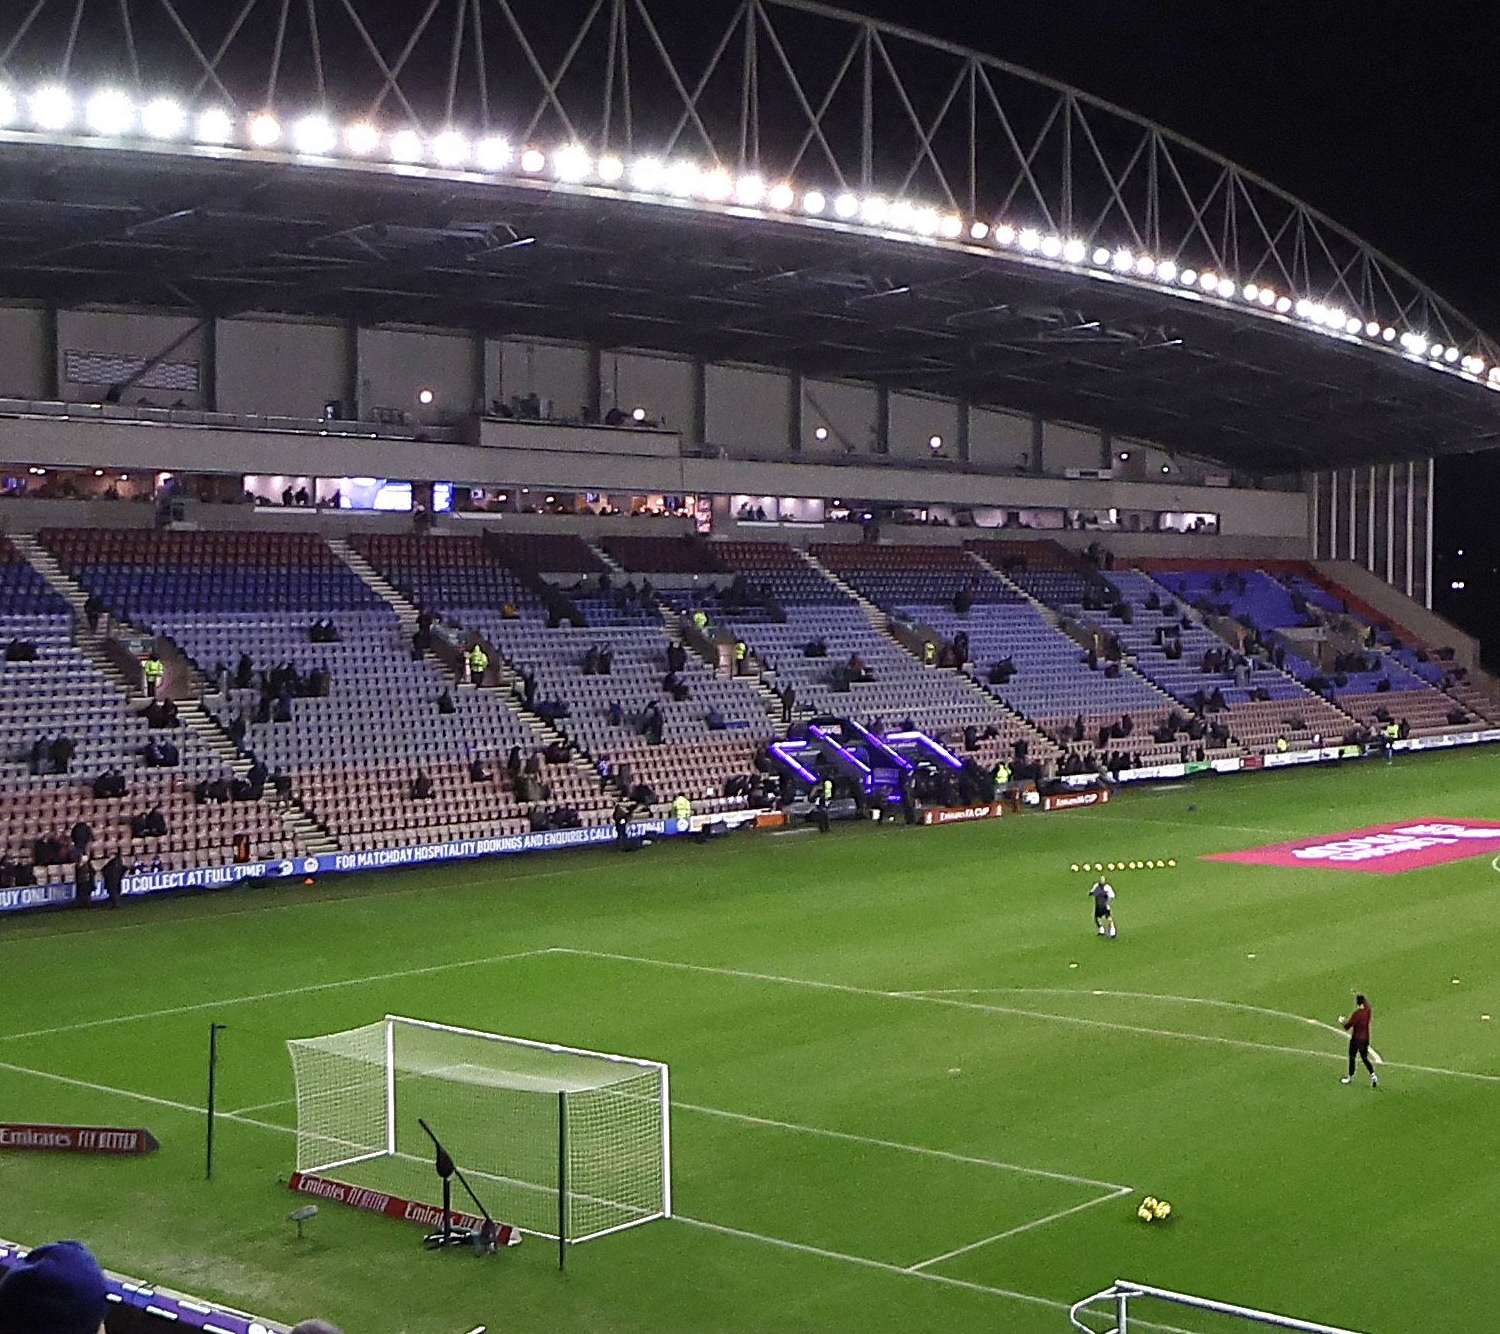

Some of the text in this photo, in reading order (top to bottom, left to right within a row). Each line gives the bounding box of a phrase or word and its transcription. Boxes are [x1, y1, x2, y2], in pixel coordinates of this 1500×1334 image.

[336, 855, 356, 869] FOR
[357, 848, 413, 867] MATCHDAY
[415, 841, 476, 861] HOSPITALITY
[477, 836, 522, 854] BOOKINGS
[524, 834, 544, 850] AND
[544, 828, 589, 848] ENQUIRIES
[590, 825, 611, 842] CALL
[132, 873, 185, 893] COLLECT
[187, 871, 204, 888] AT
[205, 866, 233, 884] FULL
[0, 1128, 71, 1146] Emirates
[298, 1175, 345, 1201] Emirates
